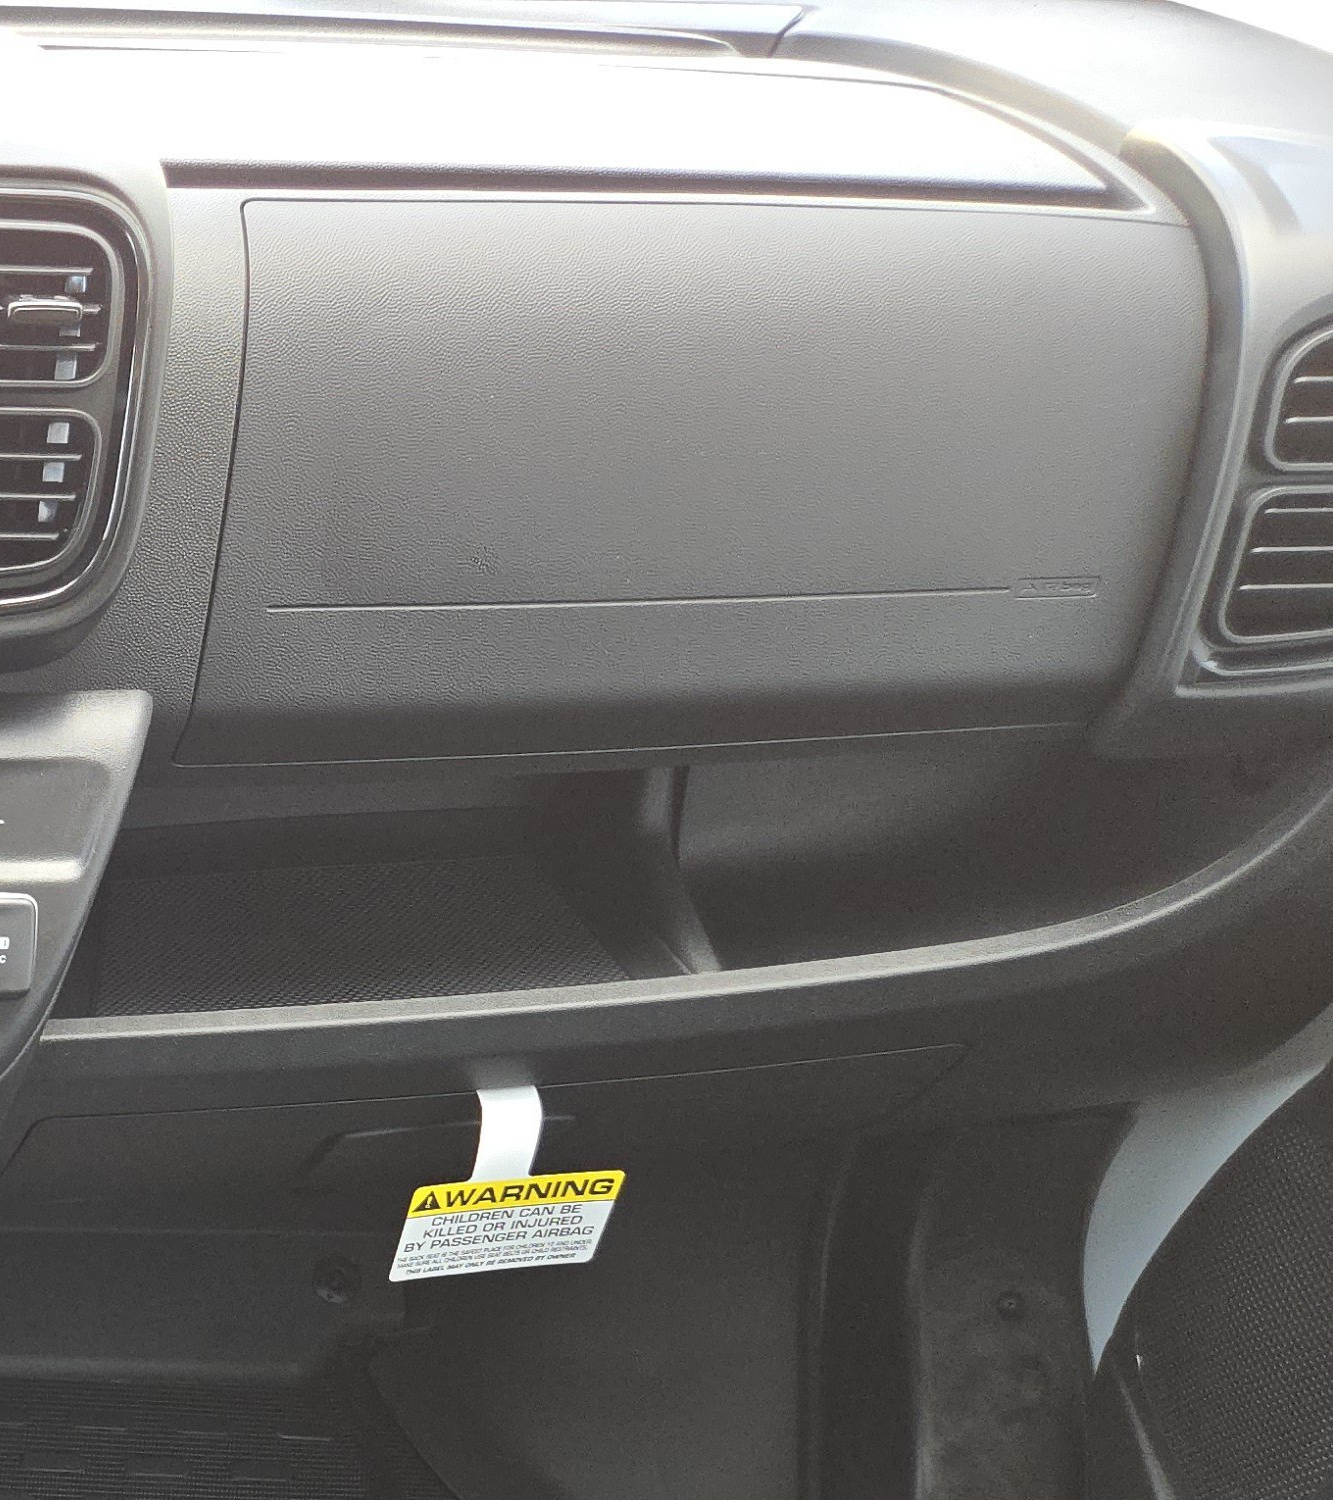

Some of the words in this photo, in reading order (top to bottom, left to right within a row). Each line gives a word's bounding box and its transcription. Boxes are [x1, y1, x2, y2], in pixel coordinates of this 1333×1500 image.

[446, 1178, 615, 1208] WARNING
[423, 1224, 477, 1238] KILLED
[482, 1221, 506, 1232] OR
[510, 1215, 583, 1229] INJURED
[432, 1210, 515, 1226] CHILDREN
[519, 1206, 555, 1218] CAN
[560, 1204, 583, 1214] BE
[404, 1241, 426, 1253] BY
[430, 1230, 528, 1250] PASSENGER
[532, 1226, 594, 1239] AIRBAG
